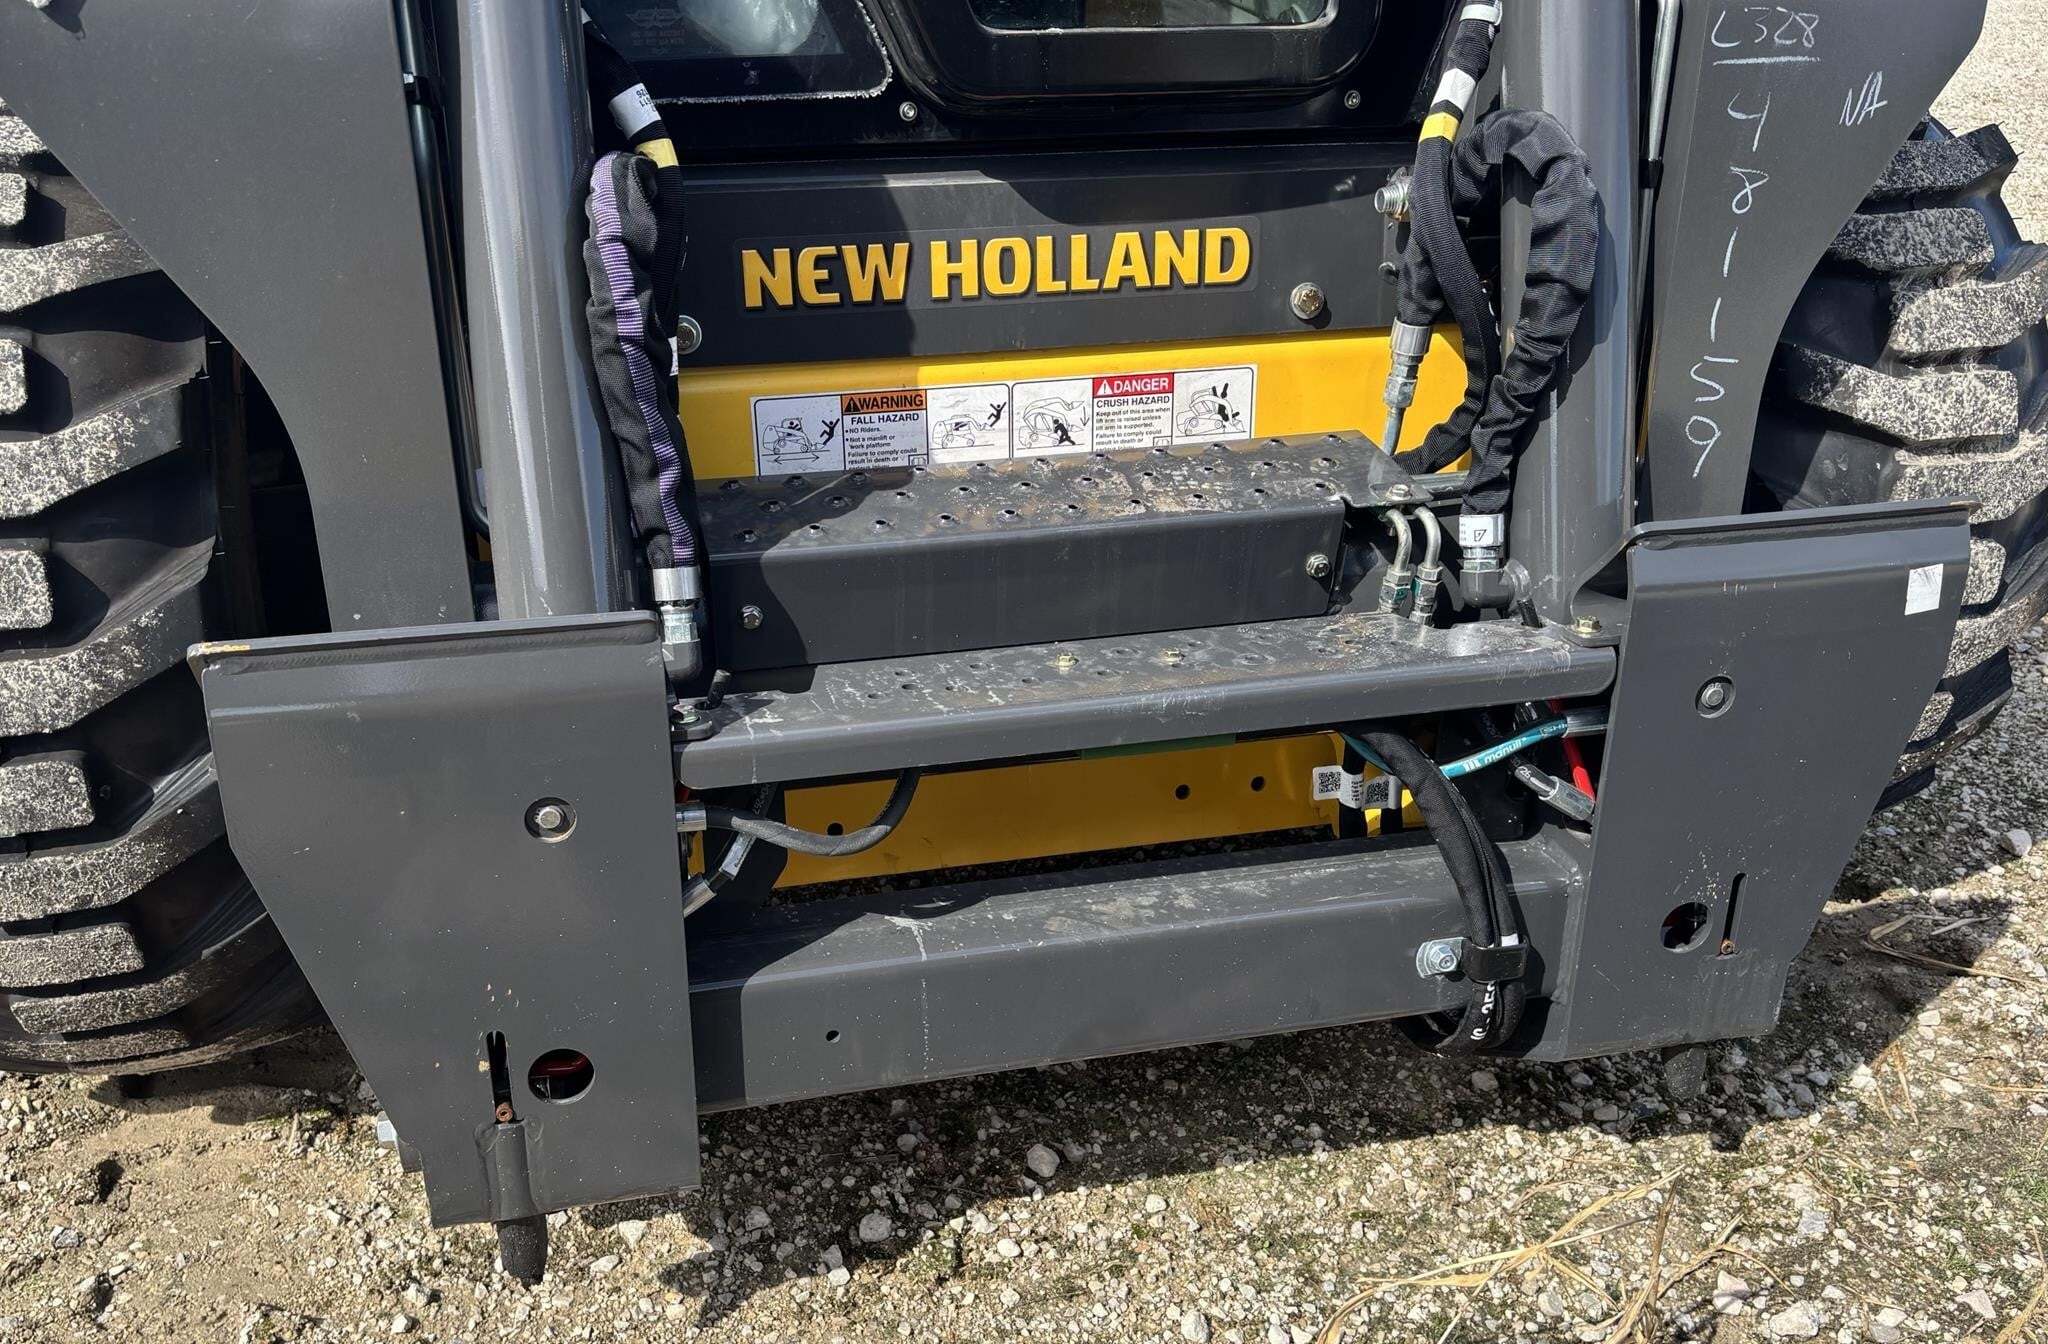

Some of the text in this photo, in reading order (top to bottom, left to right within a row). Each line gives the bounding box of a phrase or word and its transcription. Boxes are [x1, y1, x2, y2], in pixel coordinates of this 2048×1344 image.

[1711, 6, 1820, 48] L328
[741, 226, 1252, 310] NEW HOLLAND
[1114, 378, 1168, 394] DANGER
[859, 394, 923, 410] WARNING
[1096, 396, 1170, 408] CRUSH HAZARD
[852, 412, 920, 426] FALL HAZARD
